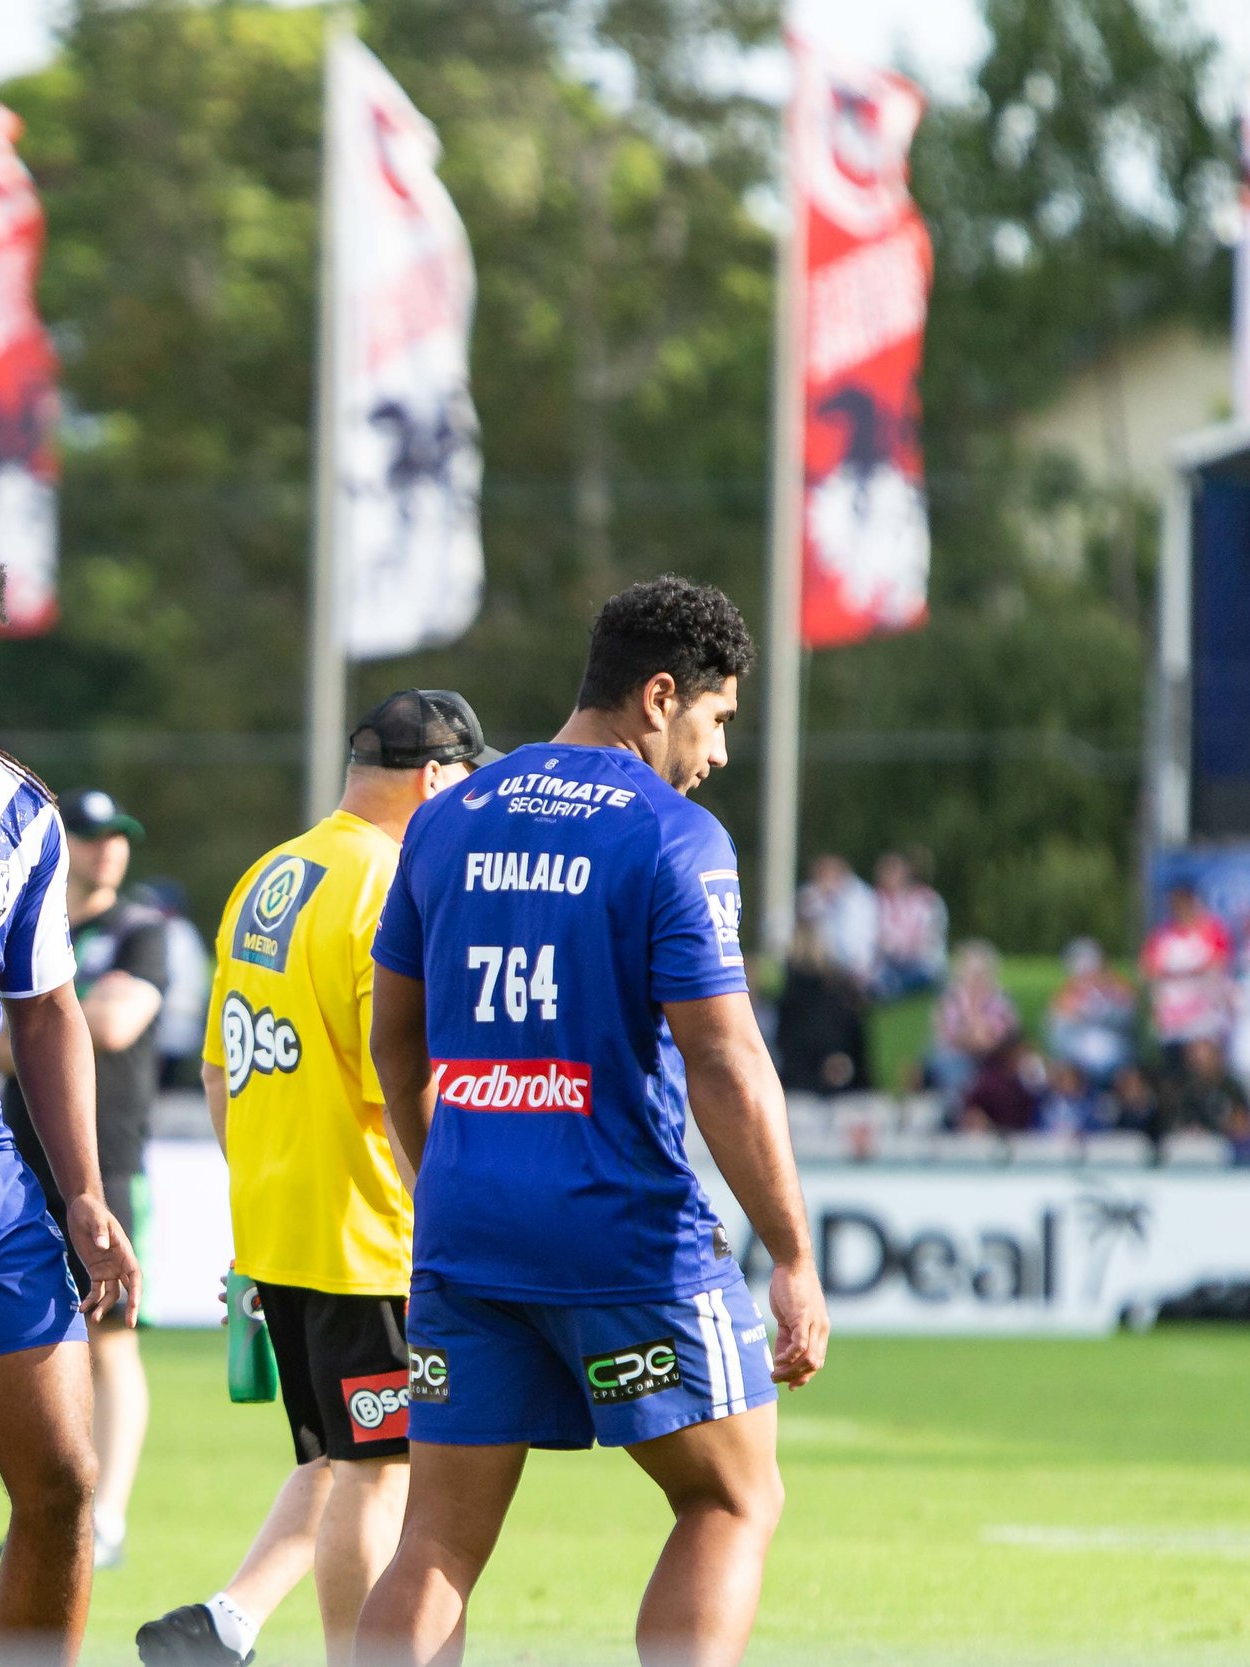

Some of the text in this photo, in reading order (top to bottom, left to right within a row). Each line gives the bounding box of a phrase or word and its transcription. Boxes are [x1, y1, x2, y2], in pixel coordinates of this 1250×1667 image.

[497, 773, 636, 808] ULTIMATE
[508, 797, 601, 819] SECURITY
[465, 852, 591, 895] FUALALO
[243, 932, 278, 957] METRO
[468, 945, 558, 1022] 764
